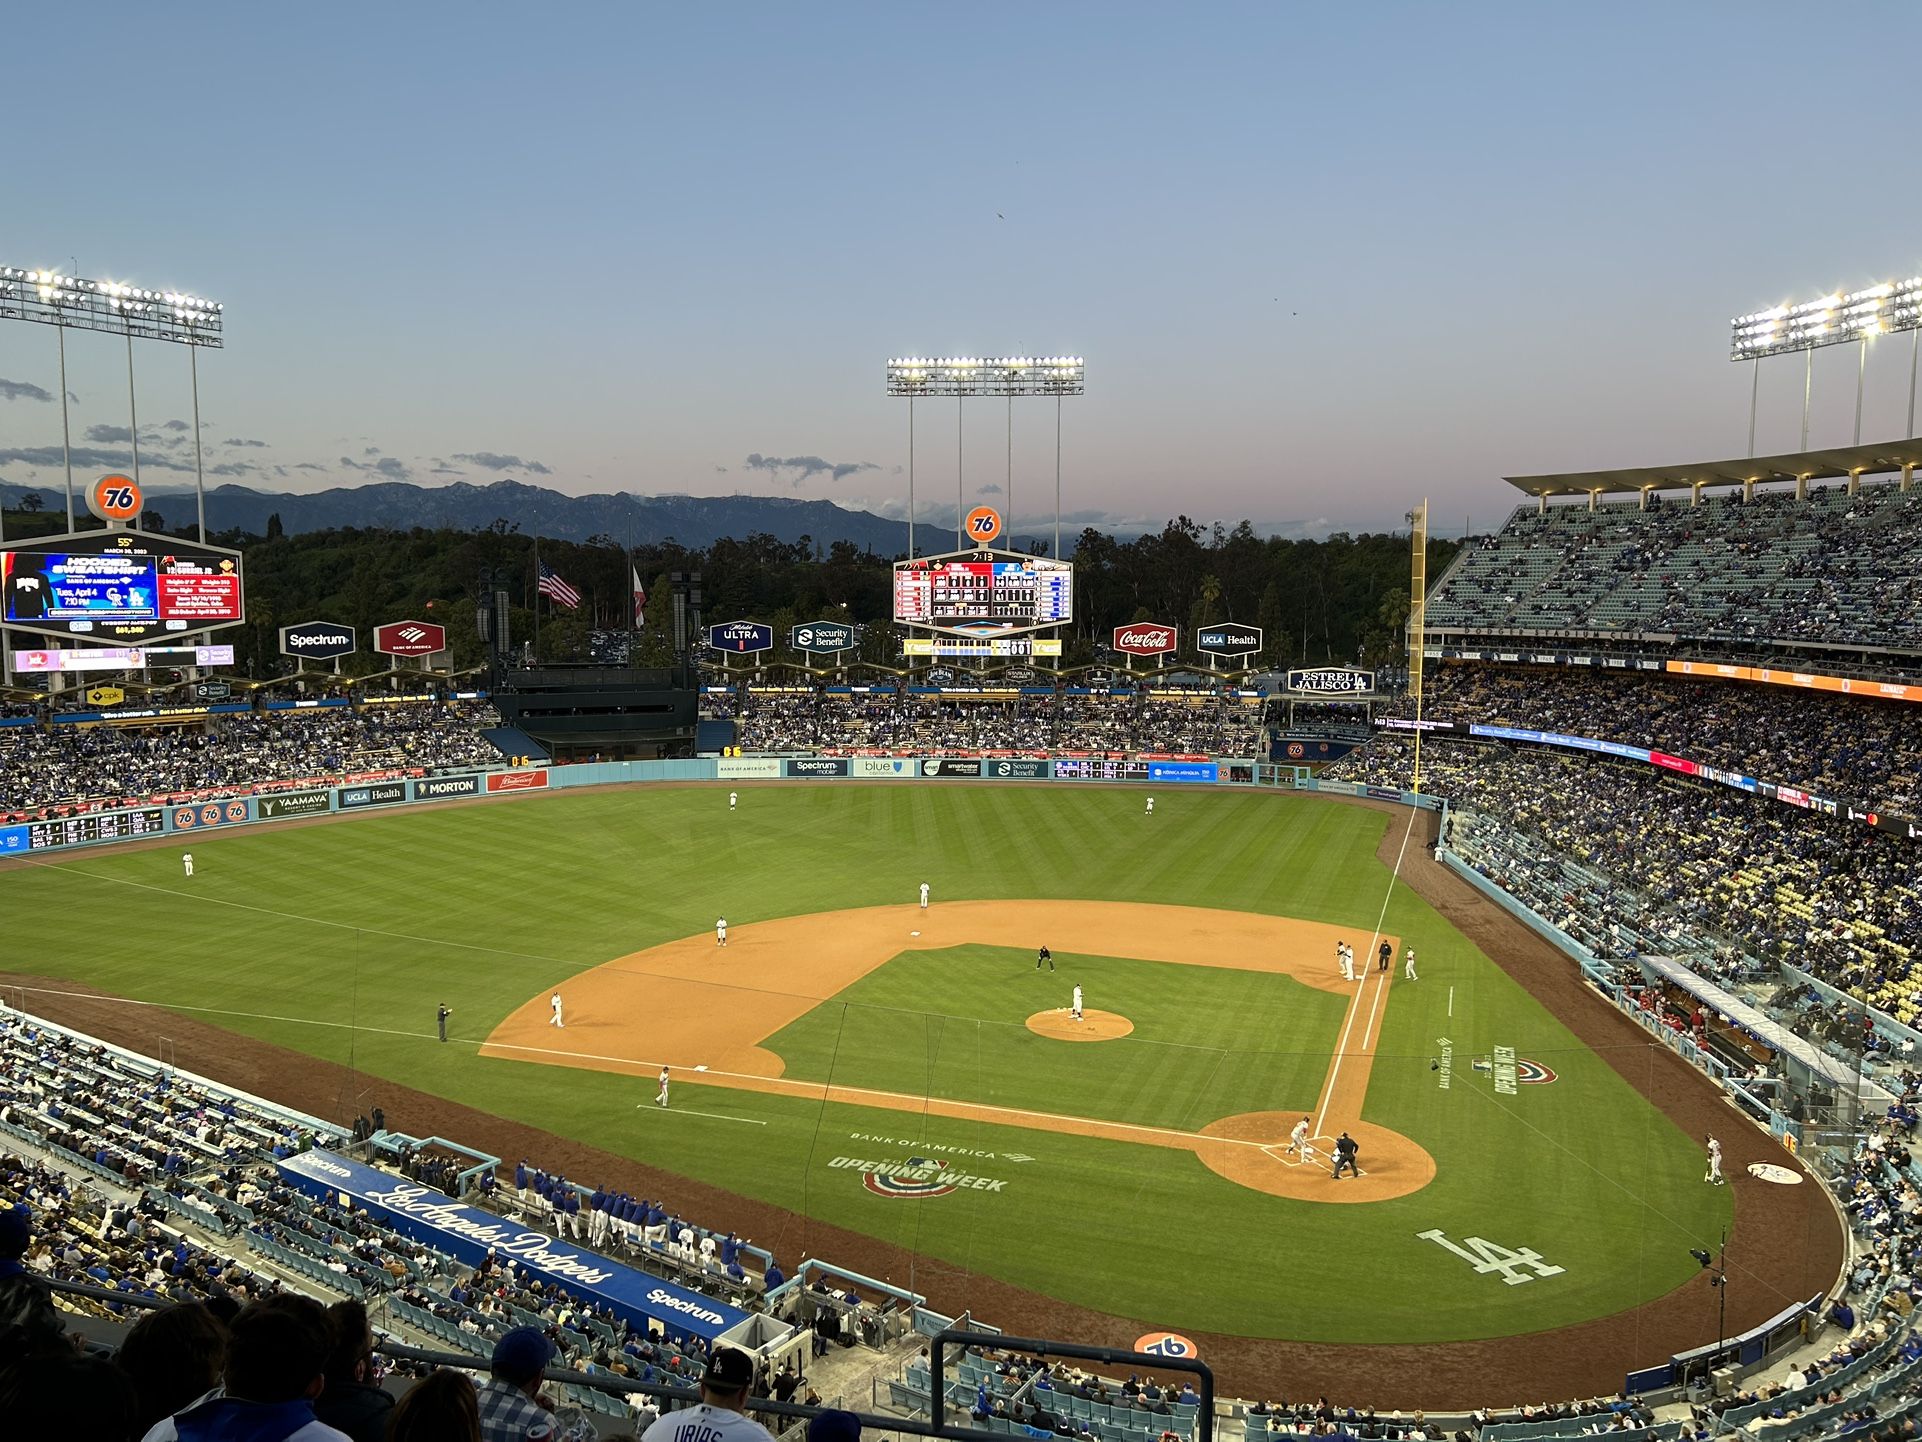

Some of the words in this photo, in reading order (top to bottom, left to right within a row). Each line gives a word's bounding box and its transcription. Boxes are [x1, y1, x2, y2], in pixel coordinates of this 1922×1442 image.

[104, 487, 134, 509] 76
[973, 517, 994, 532] 76
[118, 538, 133, 547] 55°
[67, 558, 132, 567] HOODED
[973, 553, 993, 561] 7:13
[52, 565, 147, 574] SWEATSHIRT
[56, 588, 74, 596] Tues,
[75, 588, 91, 598] April
[724, 630, 759, 640] ULTRA
[816, 629, 848, 639] Security
[1465, 627, 1524, 635] DODGER
[1535, 629, 1600, 638] STADIUM
[1611, 632, 1643, 640] CLUB
[290, 634, 347, 649] Spectrum
[816, 638, 844, 646] Benefit
[1203, 635, 1223, 644] UCLA
[1227, 635, 1257, 645] Health
[1296, 681, 1351, 690] JALISCO
[103, 691, 120, 700] cpk
[1374, 718, 1386, 726] 7:13
[1290, 745, 1302, 754] 76
[796, 761, 836, 770] Spectrum
[865, 761, 891, 772] blue
[429, 781, 474, 794] MORTON
[347, 793, 368, 802] UCLA
[372, 788, 401, 801] Health
[203, 808, 219, 820] 76
[228, 804, 245, 816] 76
[177, 812, 193, 824] 76
[1440, 1046, 1453, 1068] AMERICA
[1494, 1045, 1516, 1064] WEEK
[1439, 1075, 1451, 1089] BANK
[1494, 1063, 1518, 1095] OPENING
[850, 1132, 895, 1144] BANK
[898, 1139, 918, 1147] OF
[921, 1143, 996, 1160] AMERICA
[301, 1153, 350, 1178] Spectrum
[827, 1156, 933, 1180] OPENING
[935, 1171, 1009, 1193] WEEK
[365, 1184, 429, 1213] Los
[414, 1203, 509, 1243] Angeles
[492, 1232, 613, 1284] Dodgers
[1416, 1229, 1568, 1287] LA
[647, 1288, 720, 1325] Spectrum
[1146, 1337, 1187, 1358] 76
[713, 1356, 723, 1374] LA
